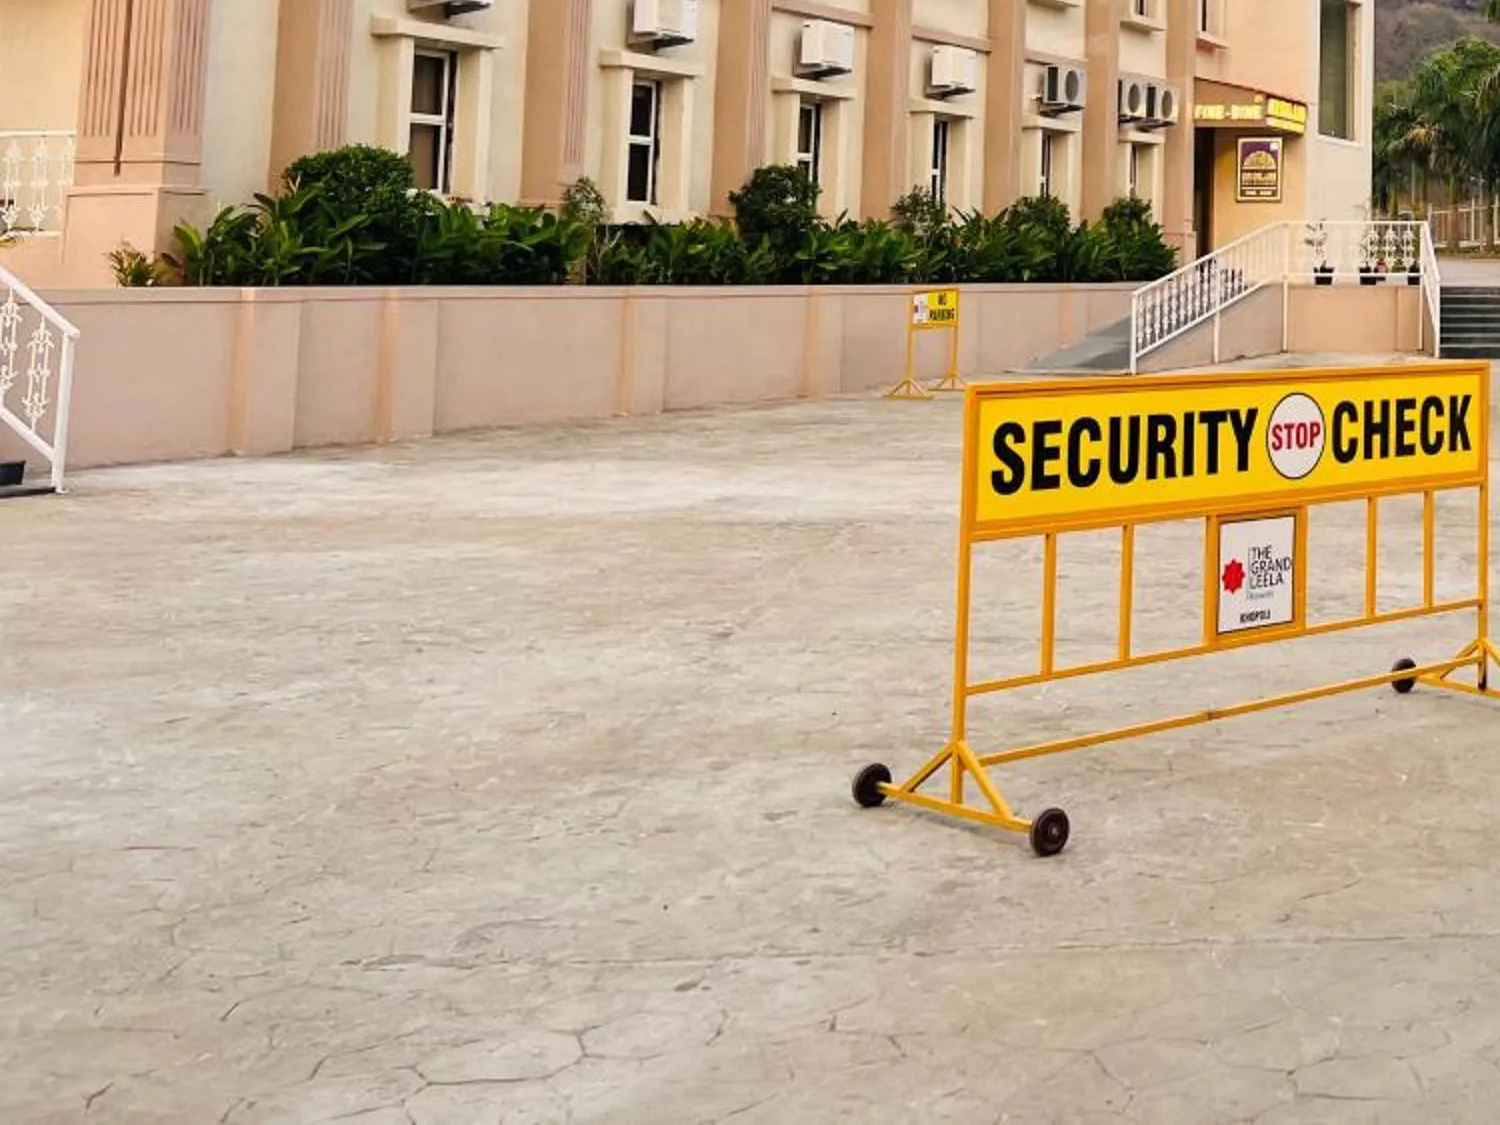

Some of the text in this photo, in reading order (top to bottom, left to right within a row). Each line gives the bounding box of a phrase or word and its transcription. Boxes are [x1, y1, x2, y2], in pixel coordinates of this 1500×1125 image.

[991, 395, 1472, 495] SECURITY STOP CHECK
[1251, 545, 1272, 560] THE
[1251, 556, 1291, 575] GRAND
[1249, 572, 1285, 589] LEELA
